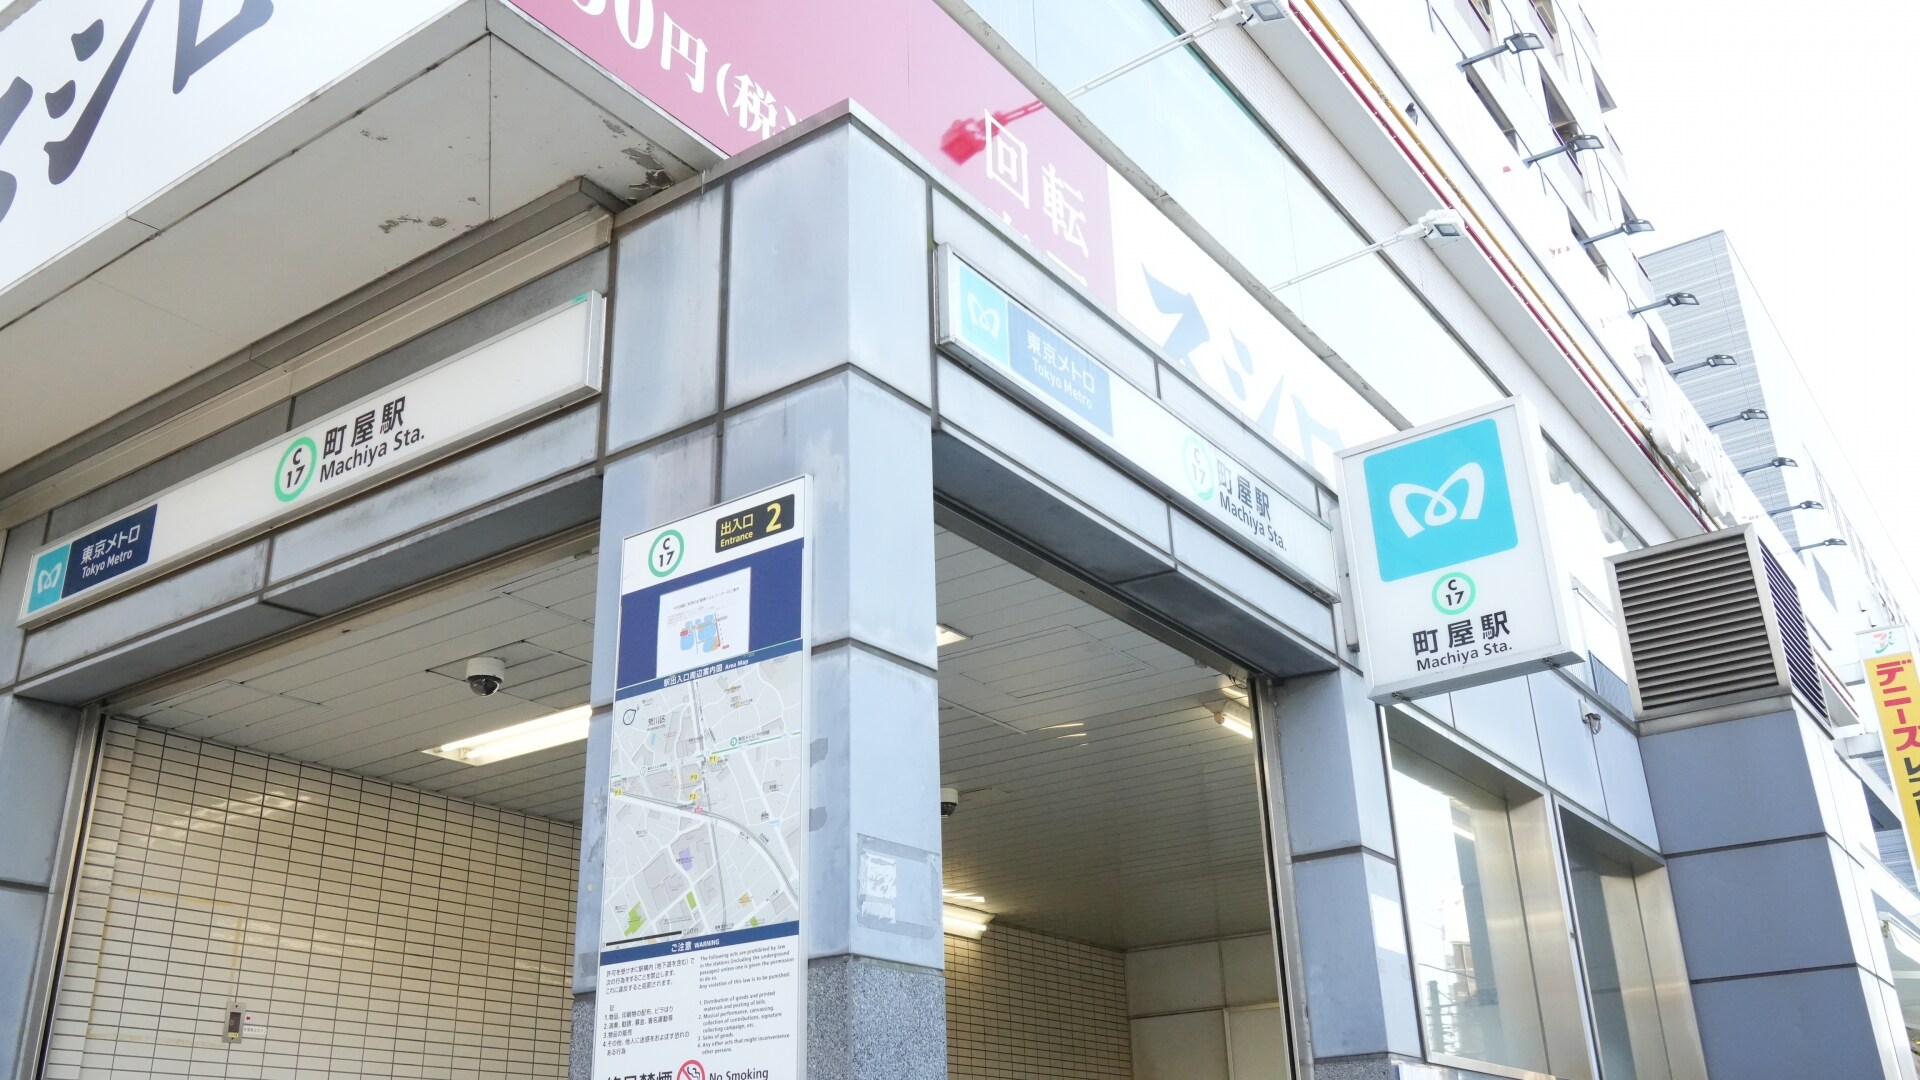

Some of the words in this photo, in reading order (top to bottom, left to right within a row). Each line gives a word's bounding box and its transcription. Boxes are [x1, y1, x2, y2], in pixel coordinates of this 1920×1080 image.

[984, 107, 1090, 259] 回転
[1026, 330, 1095, 394] 東京メトロ
[1032, 356, 1062, 389] Tokyo
[1063, 378, 1093, 409] Metro
[322, 396, 406, 460] 町屋駅
[292, 448, 302, 465] C
[320, 442, 388, 483] Machiya
[393, 428, 425, 451] Sta.
[286, 465, 305, 488] 17
[1217, 459, 1271, 522] 町屋駅
[720, 514, 754, 536] 出入口
[766, 502, 782, 533] 2
[1219, 491, 1265, 536] Machiya
[1268, 524, 1287, 552] Sta.
[80, 524, 140, 564] 東京メトロ
[662, 538, 670, 550] C
[720, 531, 753, 548] Entrance
[82, 562, 104, 578] Tokyo
[106, 550, 133, 569] Metro
[659, 551, 675, 567] 17
[1446, 590, 1464, 606] 17
[1447, 579, 1458, 591] C
[1412, 610, 1510, 656] 町屋駅
[1416, 650, 1479, 671] Machiya
[1483, 642, 1512, 656] Sta.
[671, 941, 692, 952] ご注意
[694, 938, 720, 949] WARNING
[725, 1068, 769, 1080] Smoking
